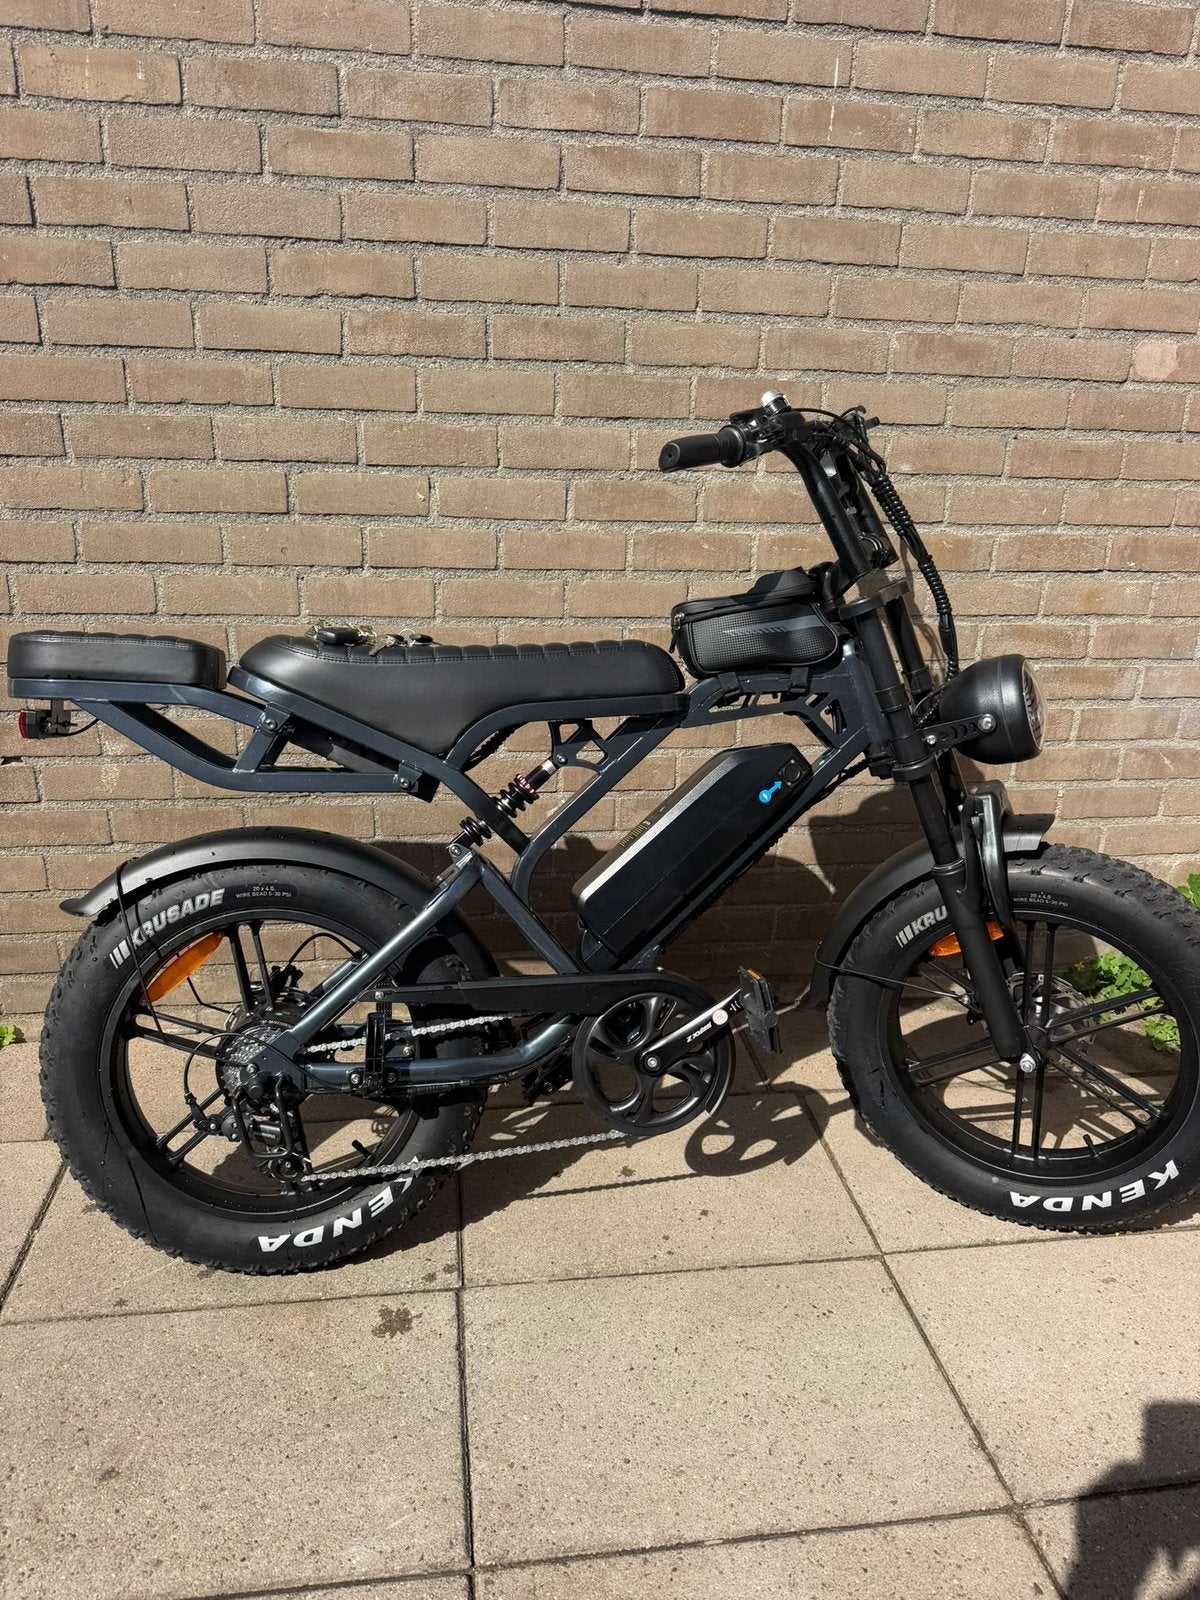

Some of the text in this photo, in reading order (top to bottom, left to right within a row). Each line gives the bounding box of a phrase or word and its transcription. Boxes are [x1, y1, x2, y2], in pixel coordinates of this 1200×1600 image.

[131, 888, 226, 947] KRUSADE
[257, 1155, 423, 1253] KENDA
[1009, 1159, 1181, 1213] KENDA
